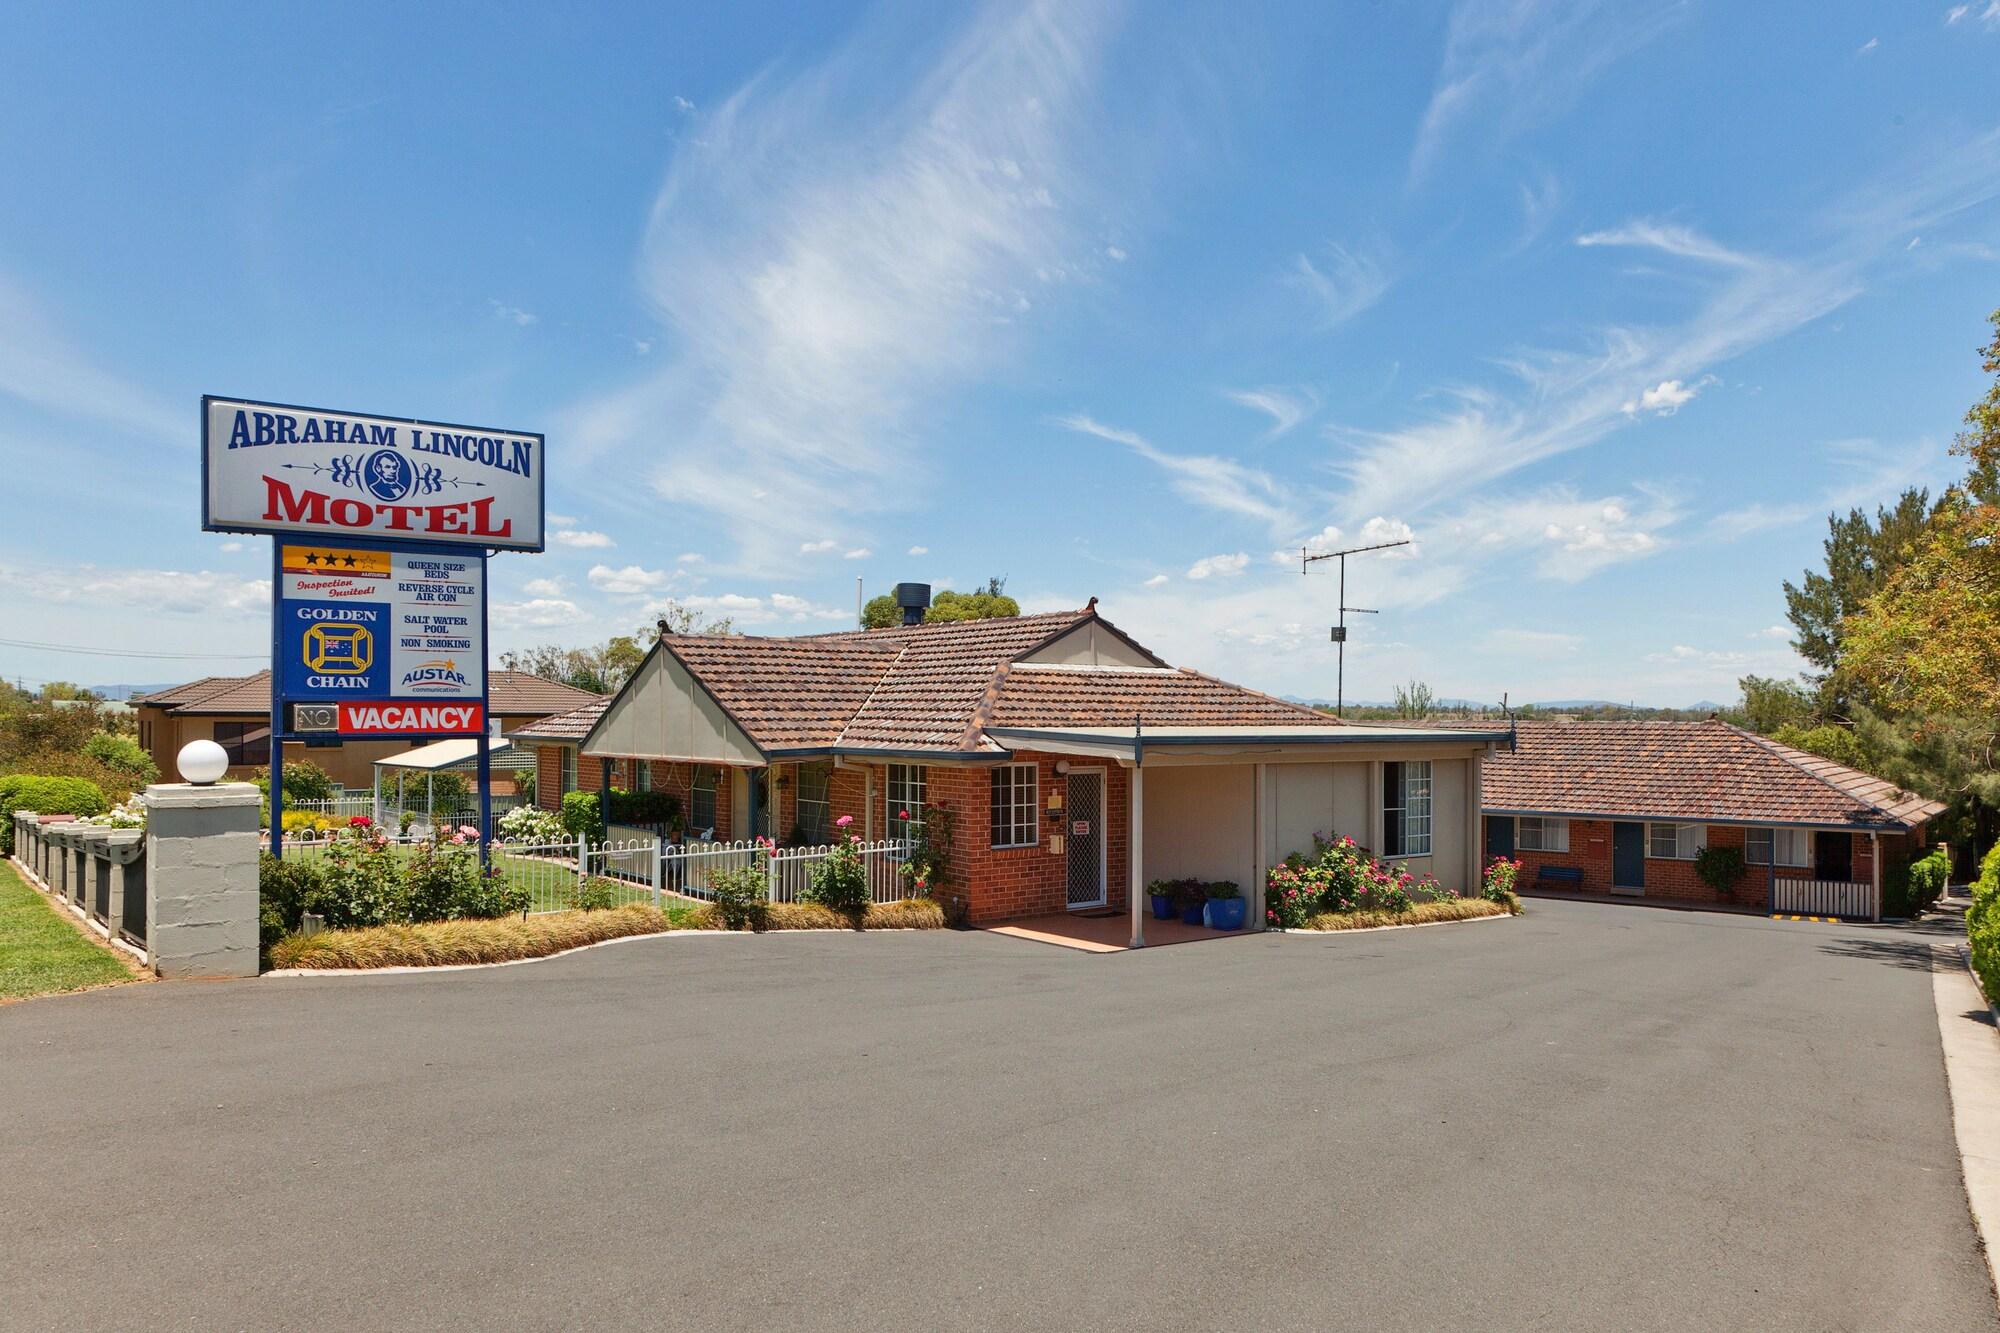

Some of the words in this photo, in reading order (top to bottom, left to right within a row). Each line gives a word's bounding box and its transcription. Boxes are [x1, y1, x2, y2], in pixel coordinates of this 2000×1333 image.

[228, 410, 396, 449] ABRAHAM
[411, 430, 532, 478] LINCOLN
[262, 475, 511, 537] MOTEL
[408, 561, 440, 570] QUEEN
[444, 563, 466, 572] SIZE
[424, 570, 450, 579] BEDS
[297, 579, 353, 590] Inspection
[398, 583, 444, 593] REVERSE
[446, 586, 474, 594] CYCLE
[328, 586, 376, 597] Invited!
[416, 593, 434, 601] AIR
[438, 594, 456, 602] CON
[297, 608, 377, 621] GOLDEN
[404, 615, 430, 624] SALT
[433, 616, 468, 626] WATER
[424, 625, 448, 634] POOL
[401, 639, 420, 647] NON
[426, 640, 470, 648] SMOKING
[306, 676, 370, 688] CHAIN
[402, 668, 467, 686] AUSTAR
[300, 709, 330, 726] NO
[348, 706, 474, 729] VACANCY
